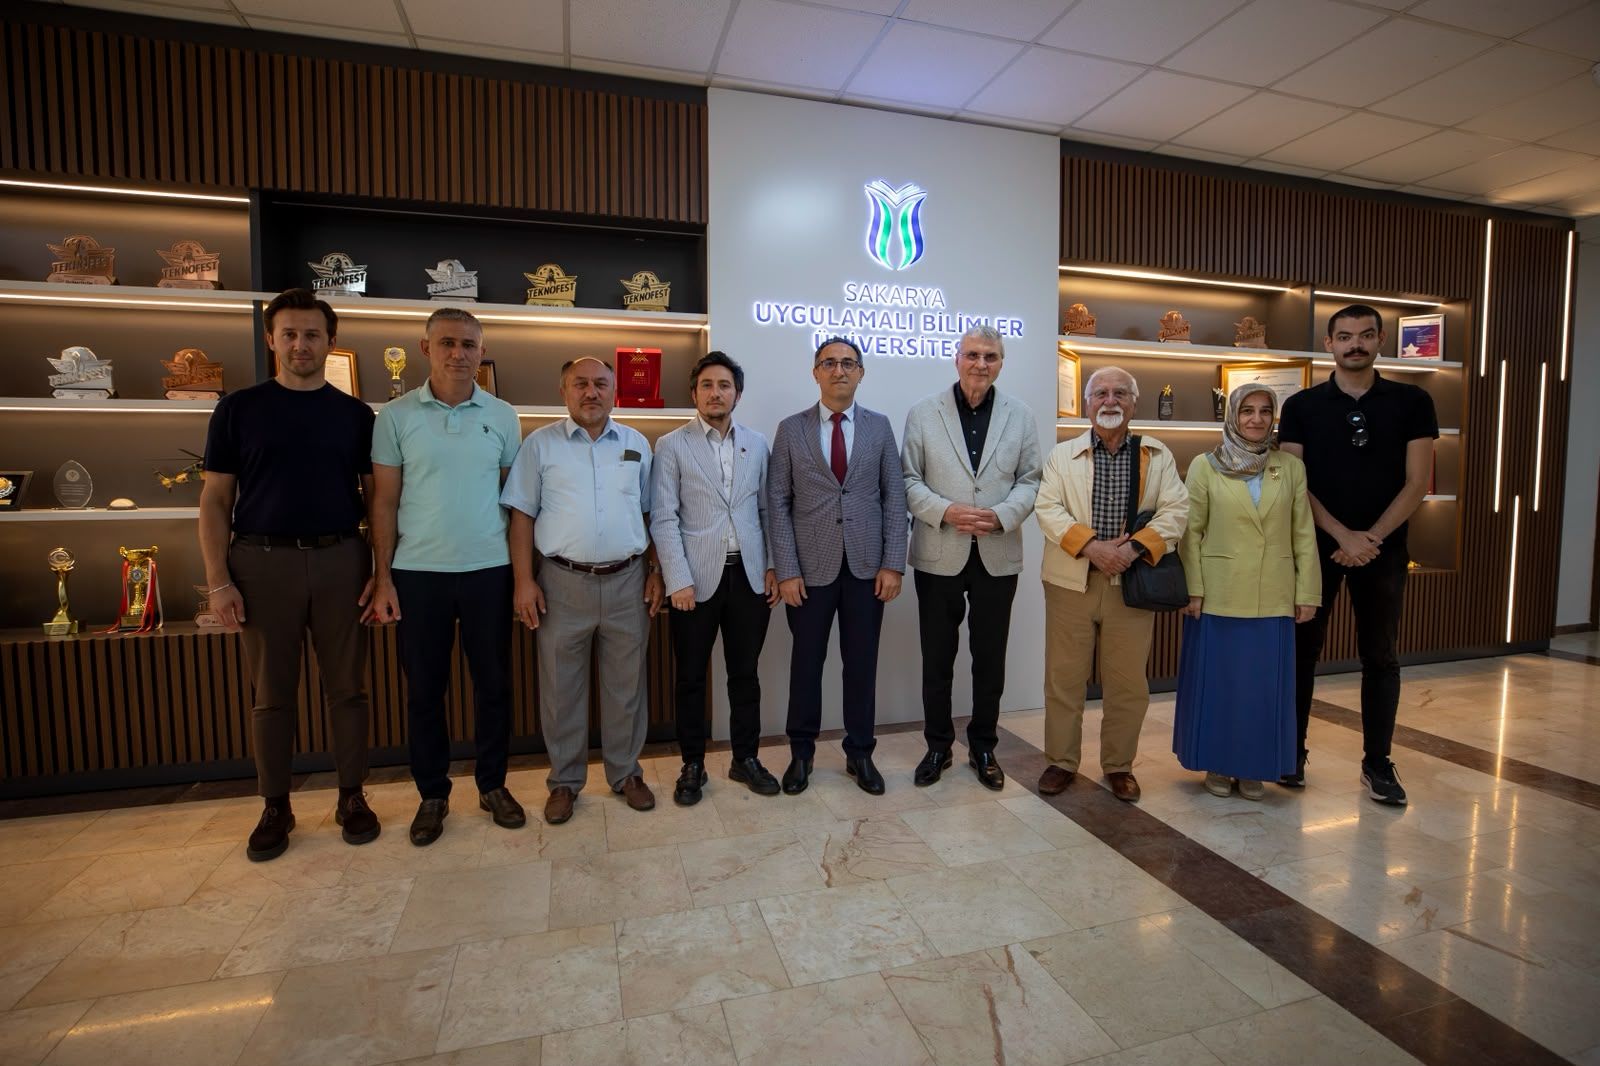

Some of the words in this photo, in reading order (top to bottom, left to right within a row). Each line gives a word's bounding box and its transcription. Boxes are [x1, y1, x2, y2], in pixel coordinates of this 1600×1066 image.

[163, 261, 217, 278] TEKNOFEST
[313, 272, 366, 290] TEKNOFEST
[528, 282, 575, 298] TEKNOFEST
[625, 288, 668, 304] TEKNOFEST
[846, 283, 945, 308] SAKARYA
[756, 303, 914, 331] UYGULAMALI
[814, 329, 960, 358] ÜİVERSİTE
